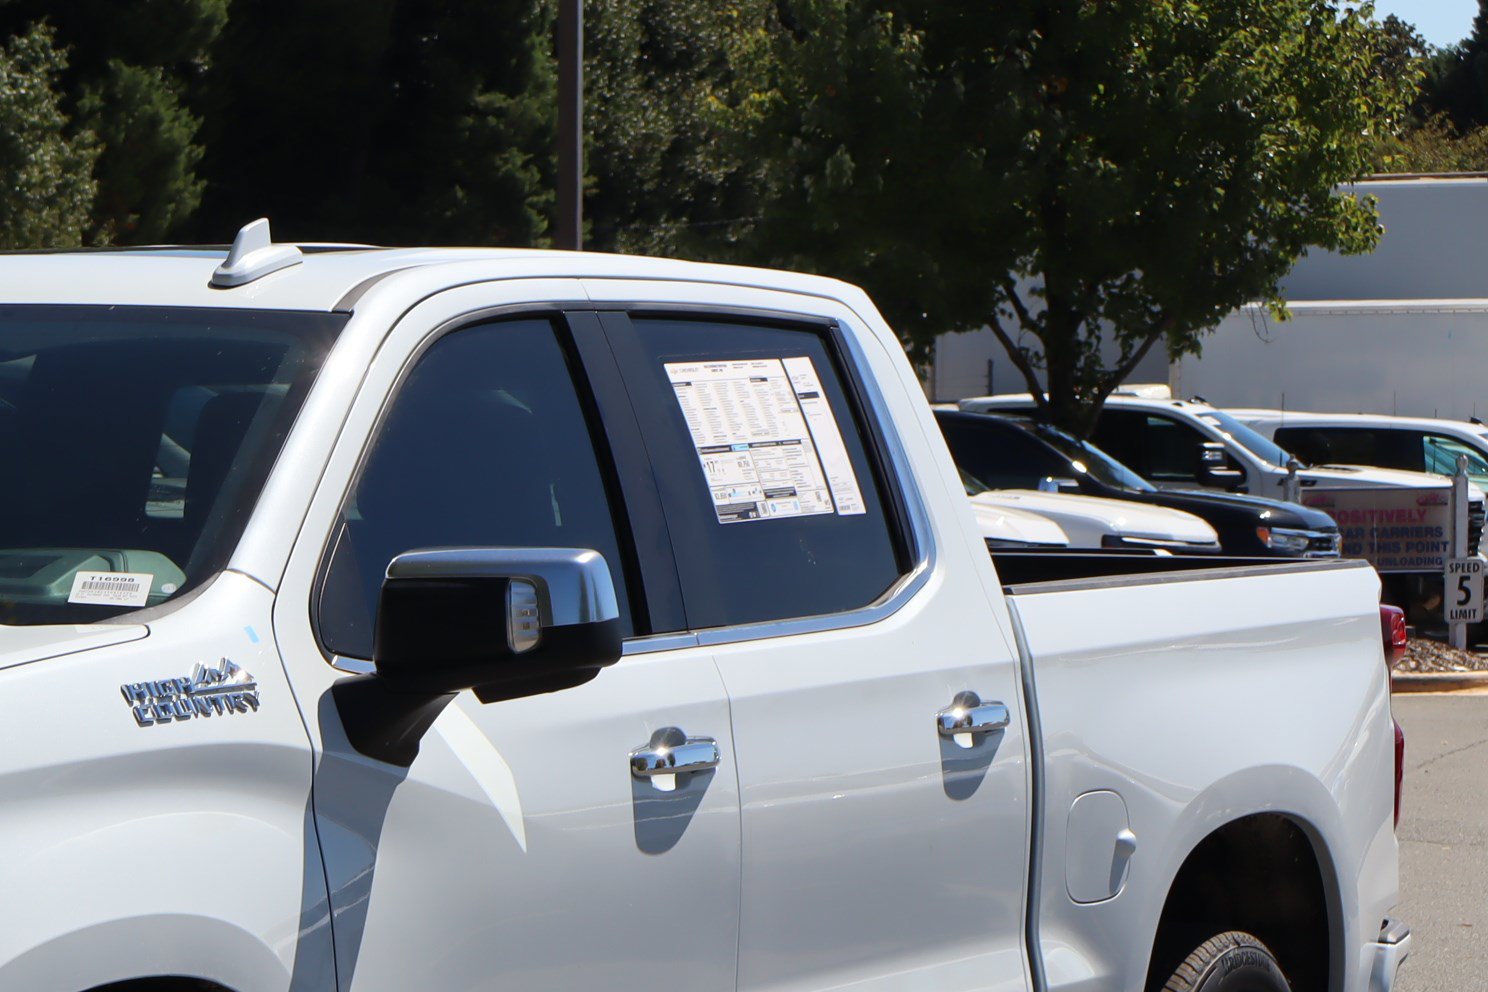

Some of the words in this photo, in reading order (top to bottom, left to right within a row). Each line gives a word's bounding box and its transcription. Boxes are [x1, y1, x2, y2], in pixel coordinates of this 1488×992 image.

[1370, 526, 1444, 538] CARRIERS
[1369, 541, 1401, 554] THIS
[1405, 541, 1450, 553] POINT
[1377, 556, 1443, 566] UNLOADING
[1449, 562, 1480, 573] SPEED
[1456, 575, 1471, 605] 5
[1450, 609, 1477, 620] LIMIT
[120, 676, 198, 707] HIGH
[132, 689, 261, 728] COUNTRY
